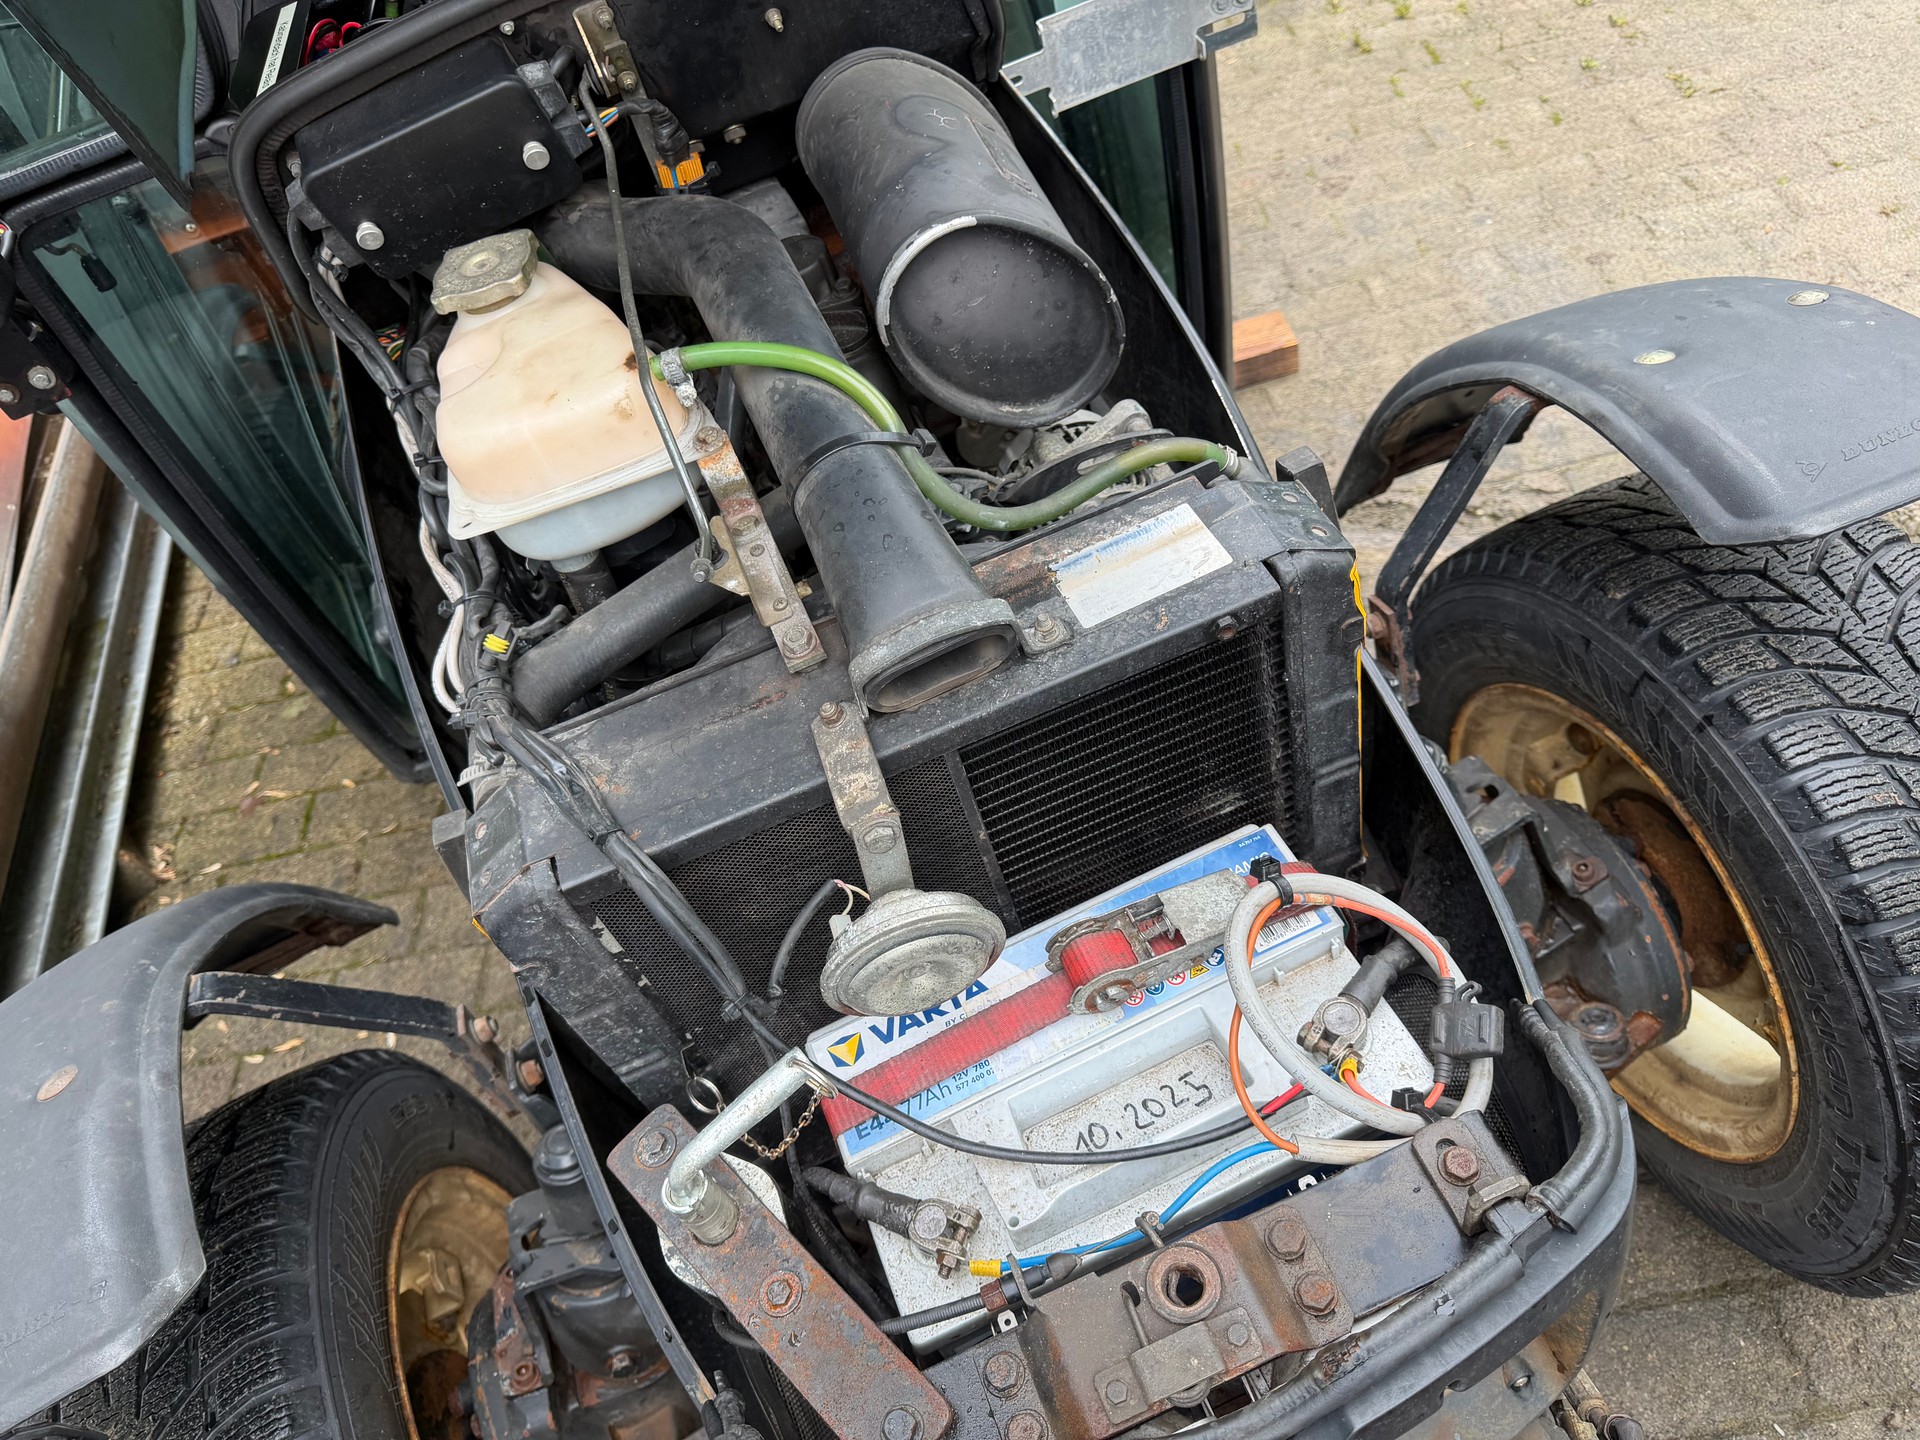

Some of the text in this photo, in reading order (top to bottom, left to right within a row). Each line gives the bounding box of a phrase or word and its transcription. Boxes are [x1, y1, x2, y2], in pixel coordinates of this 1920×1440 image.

[945, 1017, 957, 1028] BY
[952, 1059, 991, 1082] 12V 780
[955, 1080, 970, 1091] 577
[971, 1073, 986, 1085] 400
[854, 1083, 953, 1140] E4 77Ah
